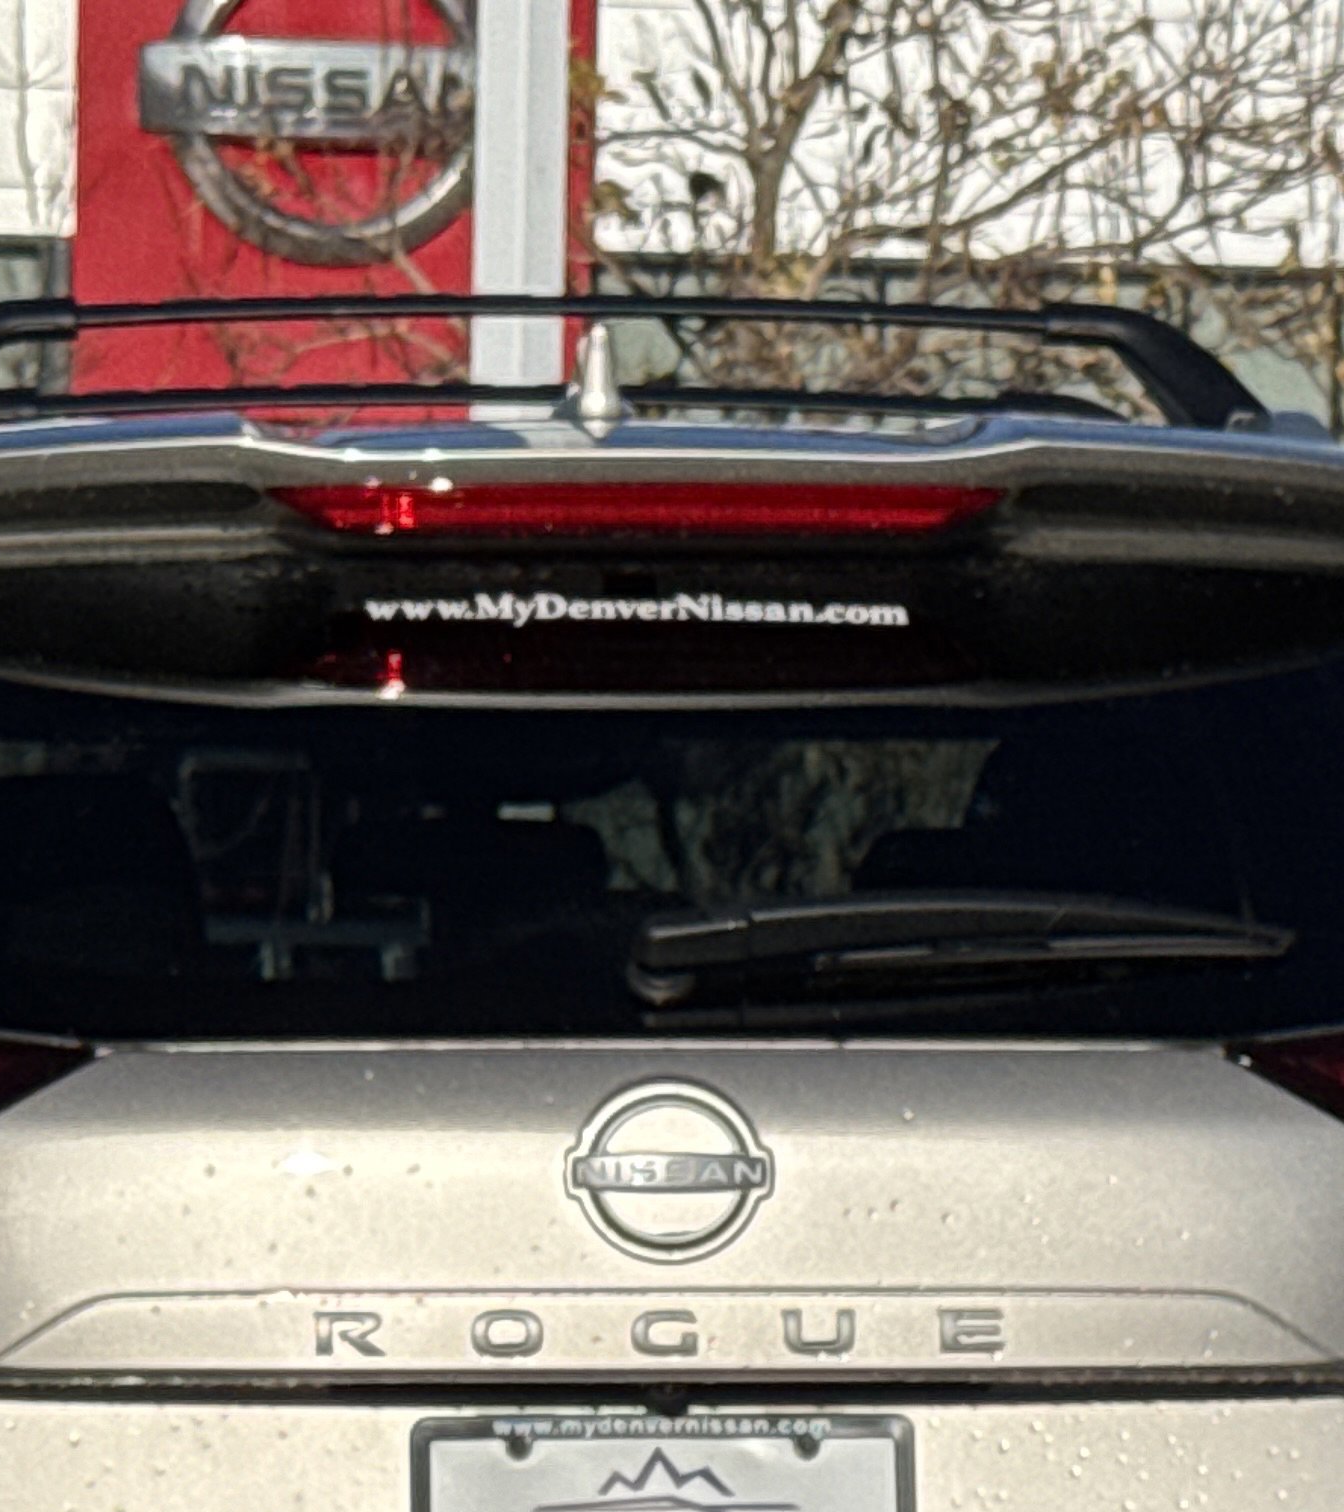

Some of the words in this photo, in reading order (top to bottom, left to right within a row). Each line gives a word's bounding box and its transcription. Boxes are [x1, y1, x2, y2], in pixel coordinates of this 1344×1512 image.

[364, 593, 909, 628] www.MyDenverNissan.com
[576, 1158, 763, 1185] NISSAN
[313, 1309, 1006, 1357] ROGUE
